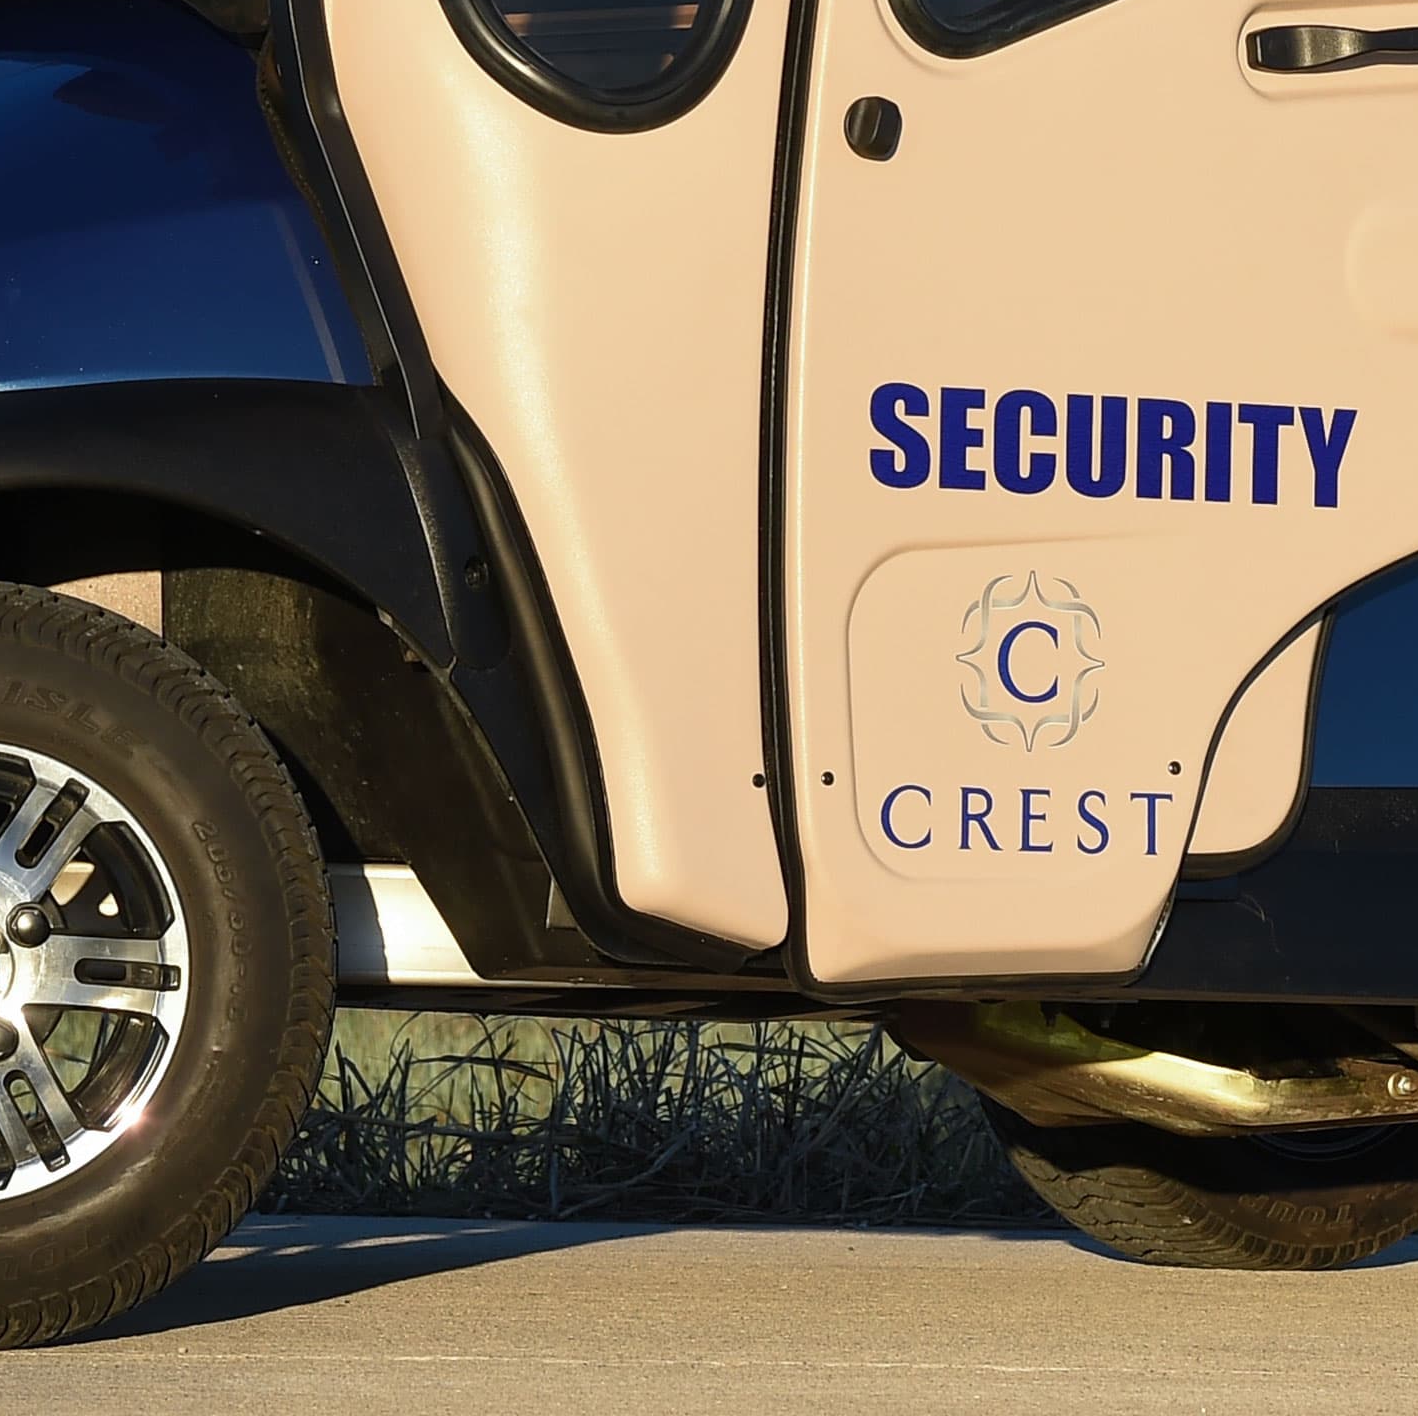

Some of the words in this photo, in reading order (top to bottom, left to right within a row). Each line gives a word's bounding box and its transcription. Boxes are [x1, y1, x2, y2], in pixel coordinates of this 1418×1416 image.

[868, 382, 1358, 509] SECURITY
[997, 620, 1060, 703] C
[880, 783, 1174, 856] CREST
